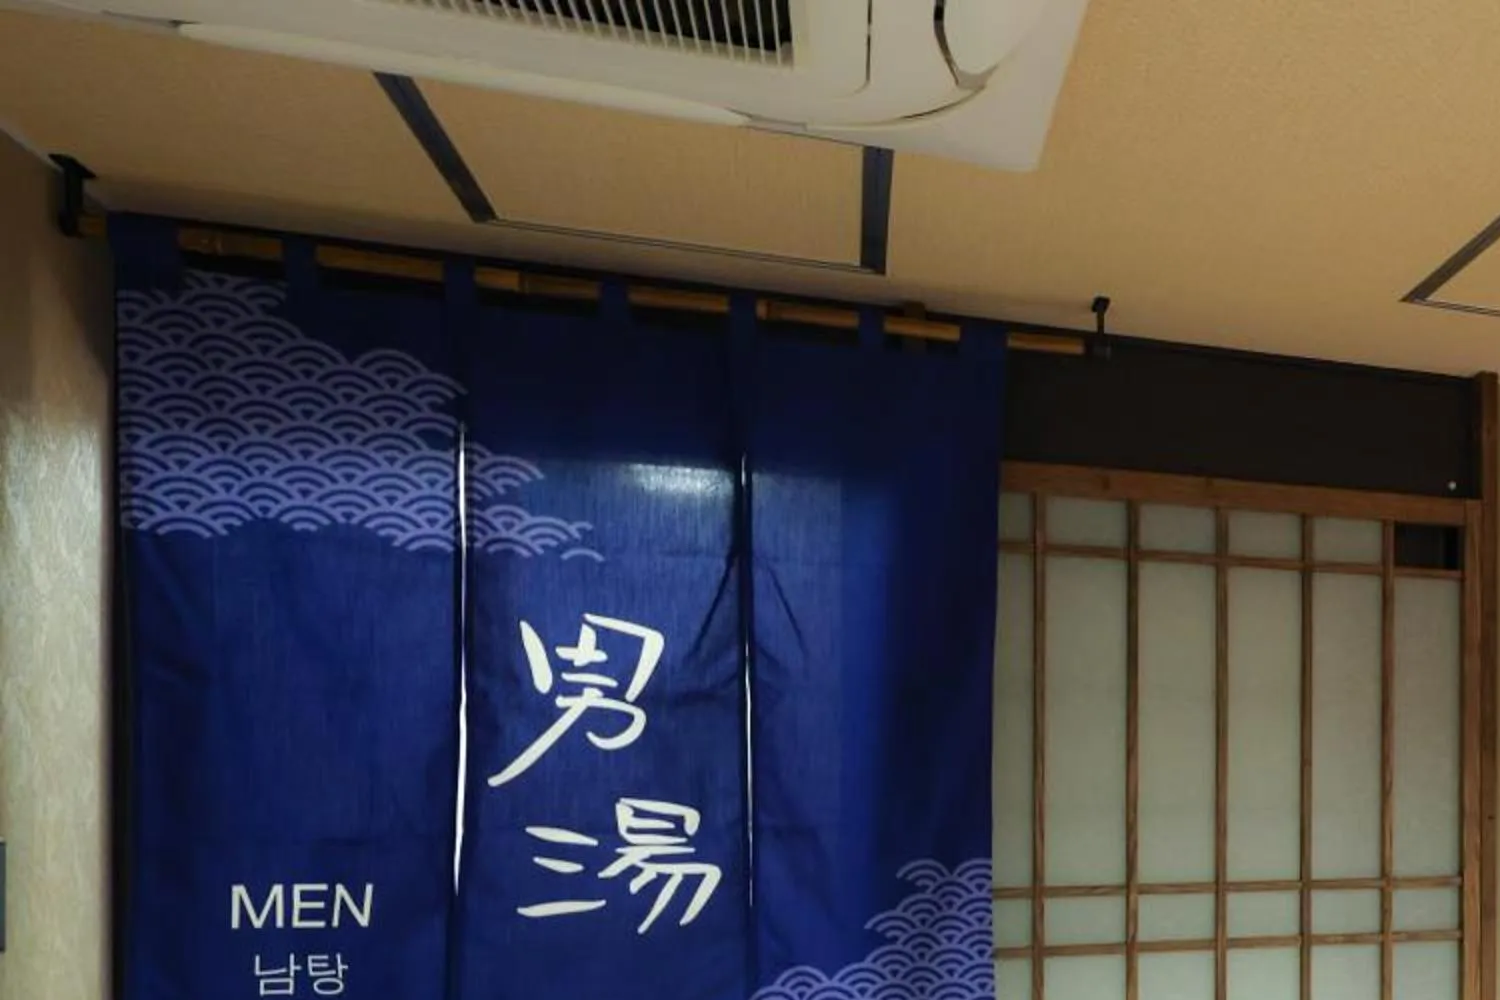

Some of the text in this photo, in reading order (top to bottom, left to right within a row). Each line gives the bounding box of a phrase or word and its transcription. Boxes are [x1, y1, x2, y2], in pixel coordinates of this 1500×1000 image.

[487, 612, 722, 934] 男湯
[230, 882, 374, 930] MEN
[253, 952, 349, 996] 남탕
